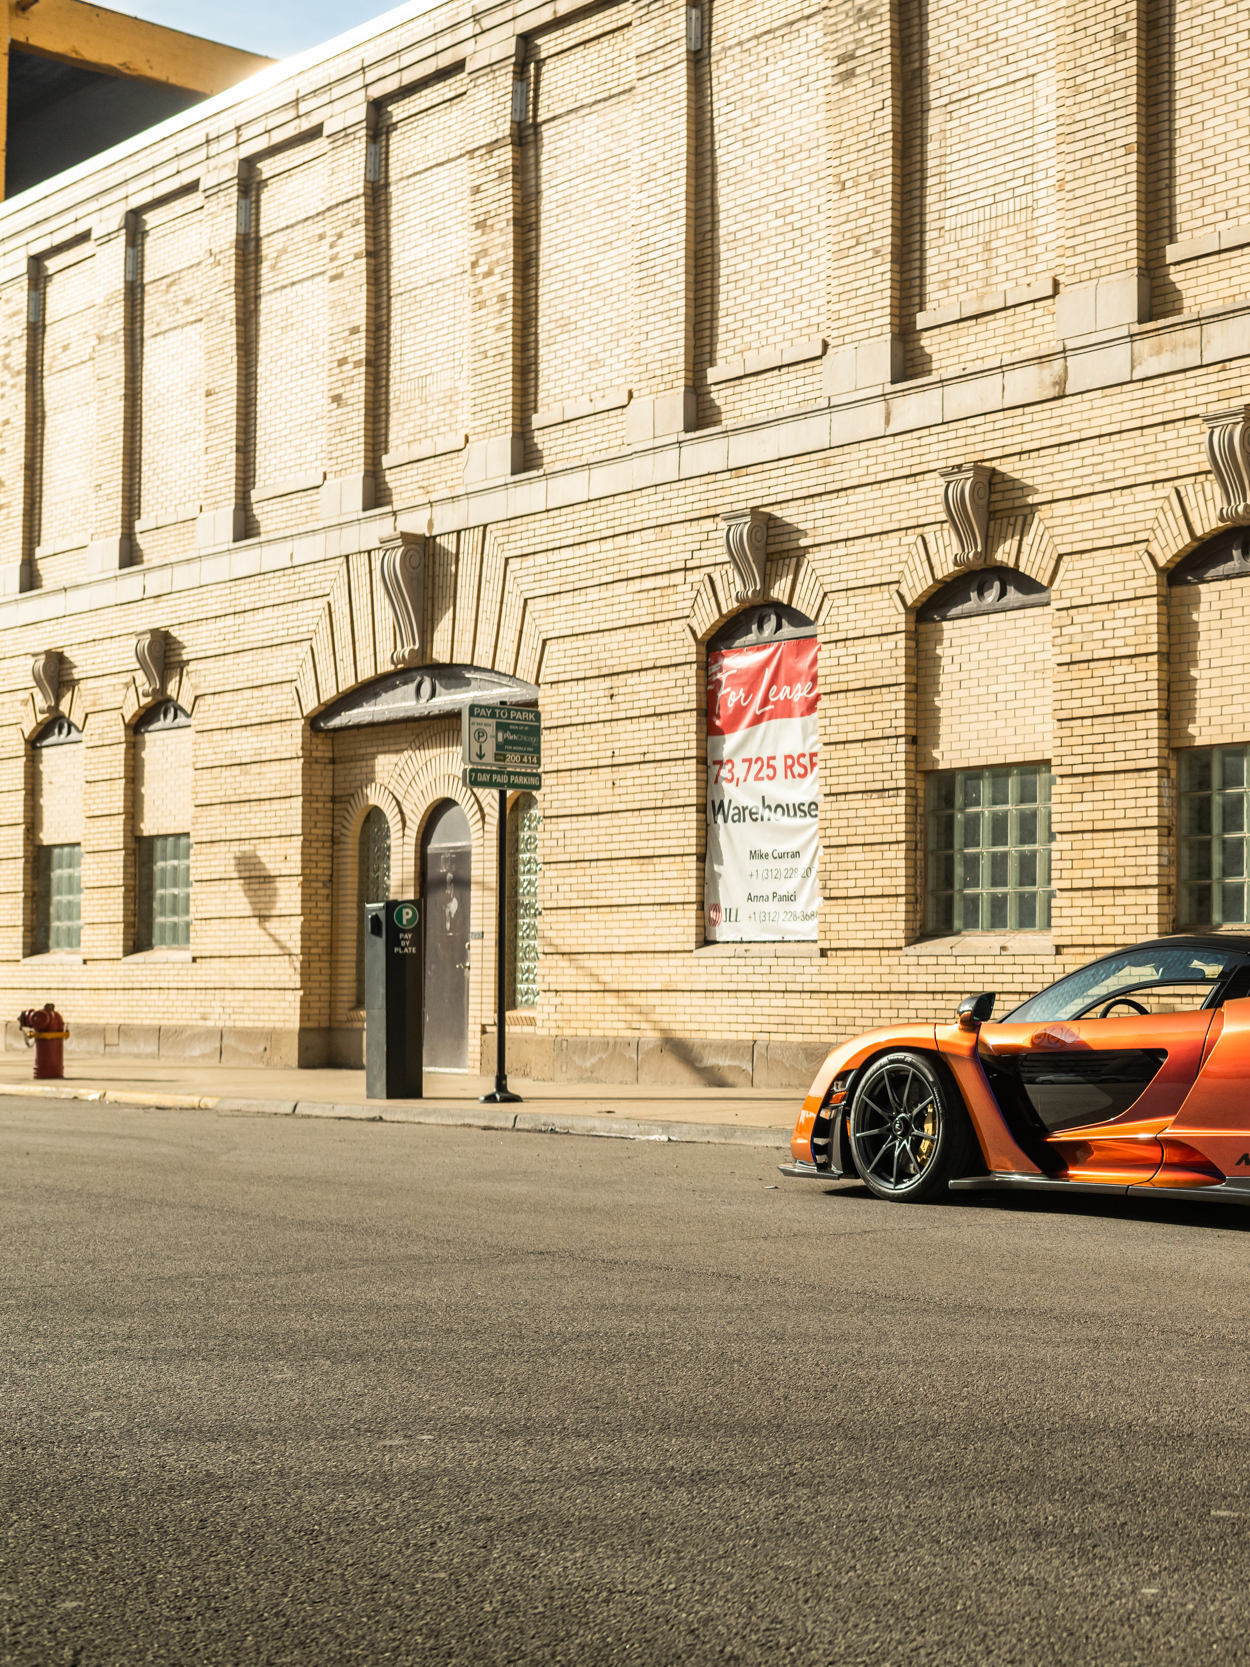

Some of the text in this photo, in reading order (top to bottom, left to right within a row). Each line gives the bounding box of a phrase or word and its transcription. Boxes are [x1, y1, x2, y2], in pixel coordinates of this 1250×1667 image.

[715, 667, 818, 715] For Lease
[474, 707, 536, 721] PAY TO PARK
[505, 754, 521, 763] 200
[523, 755, 537, 764] 414
[712, 756, 777, 787] 73,725
[471, 773, 539, 786] 7 DAY PAID PARKING
[711, 796, 818, 824] Warehouse
[749, 849, 801, 861] Mike Curran
[748, 868, 759, 880] +1
[761, 868, 782, 881] (312)
[746, 891, 797, 903] Anna Panici
[402, 908, 413, 926] P
[723, 907, 741, 923] JLL
[747, 911, 757, 922] +1
[758, 911, 780, 923] (312)
